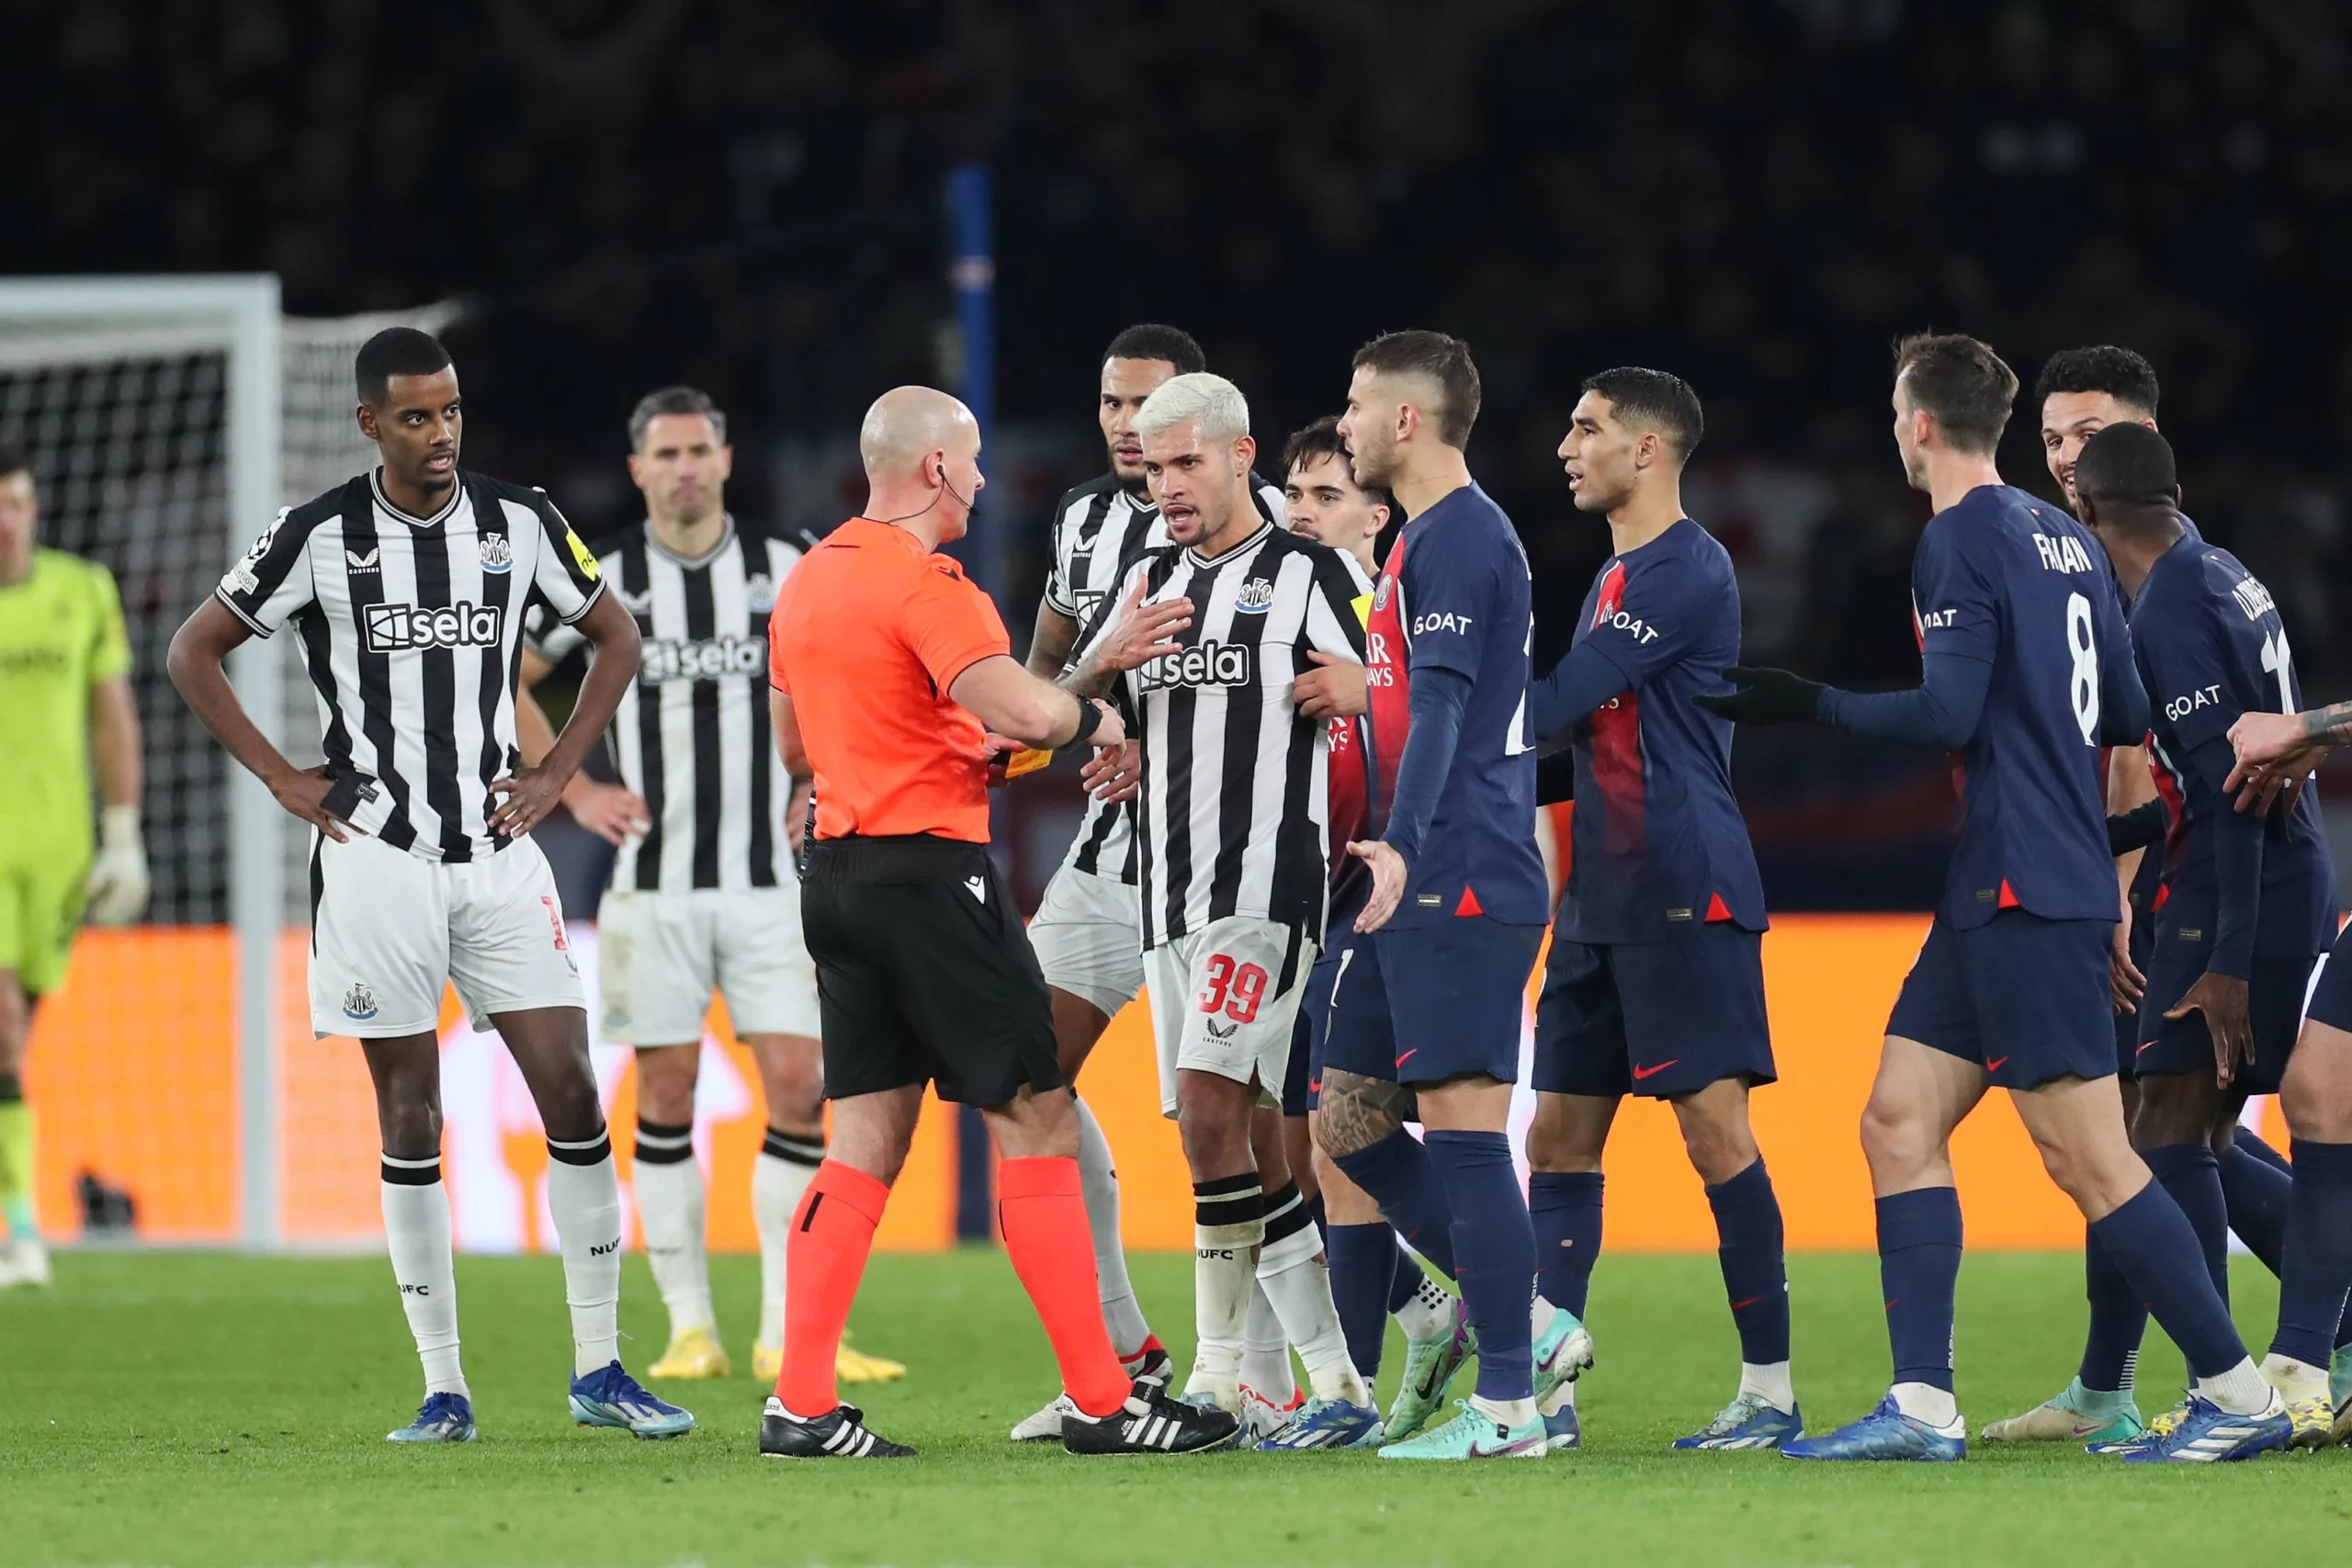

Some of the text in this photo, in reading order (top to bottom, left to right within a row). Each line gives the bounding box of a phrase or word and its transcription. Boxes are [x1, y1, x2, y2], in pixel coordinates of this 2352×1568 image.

[413, 604, 496, 644] sela
[1413, 612, 1473, 636] GOAT
[1610, 611, 1659, 644] OAT
[680, 636, 763, 676] sela
[1163, 643, 1243, 683] sela
[2067, 591, 2099, 747] 8
[2165, 683, 2221, 722] GOAT
[1199, 953, 1268, 1024] 39
[1197, 1249, 1233, 1260] UFC
[398, 1284, 429, 1296] UFC
